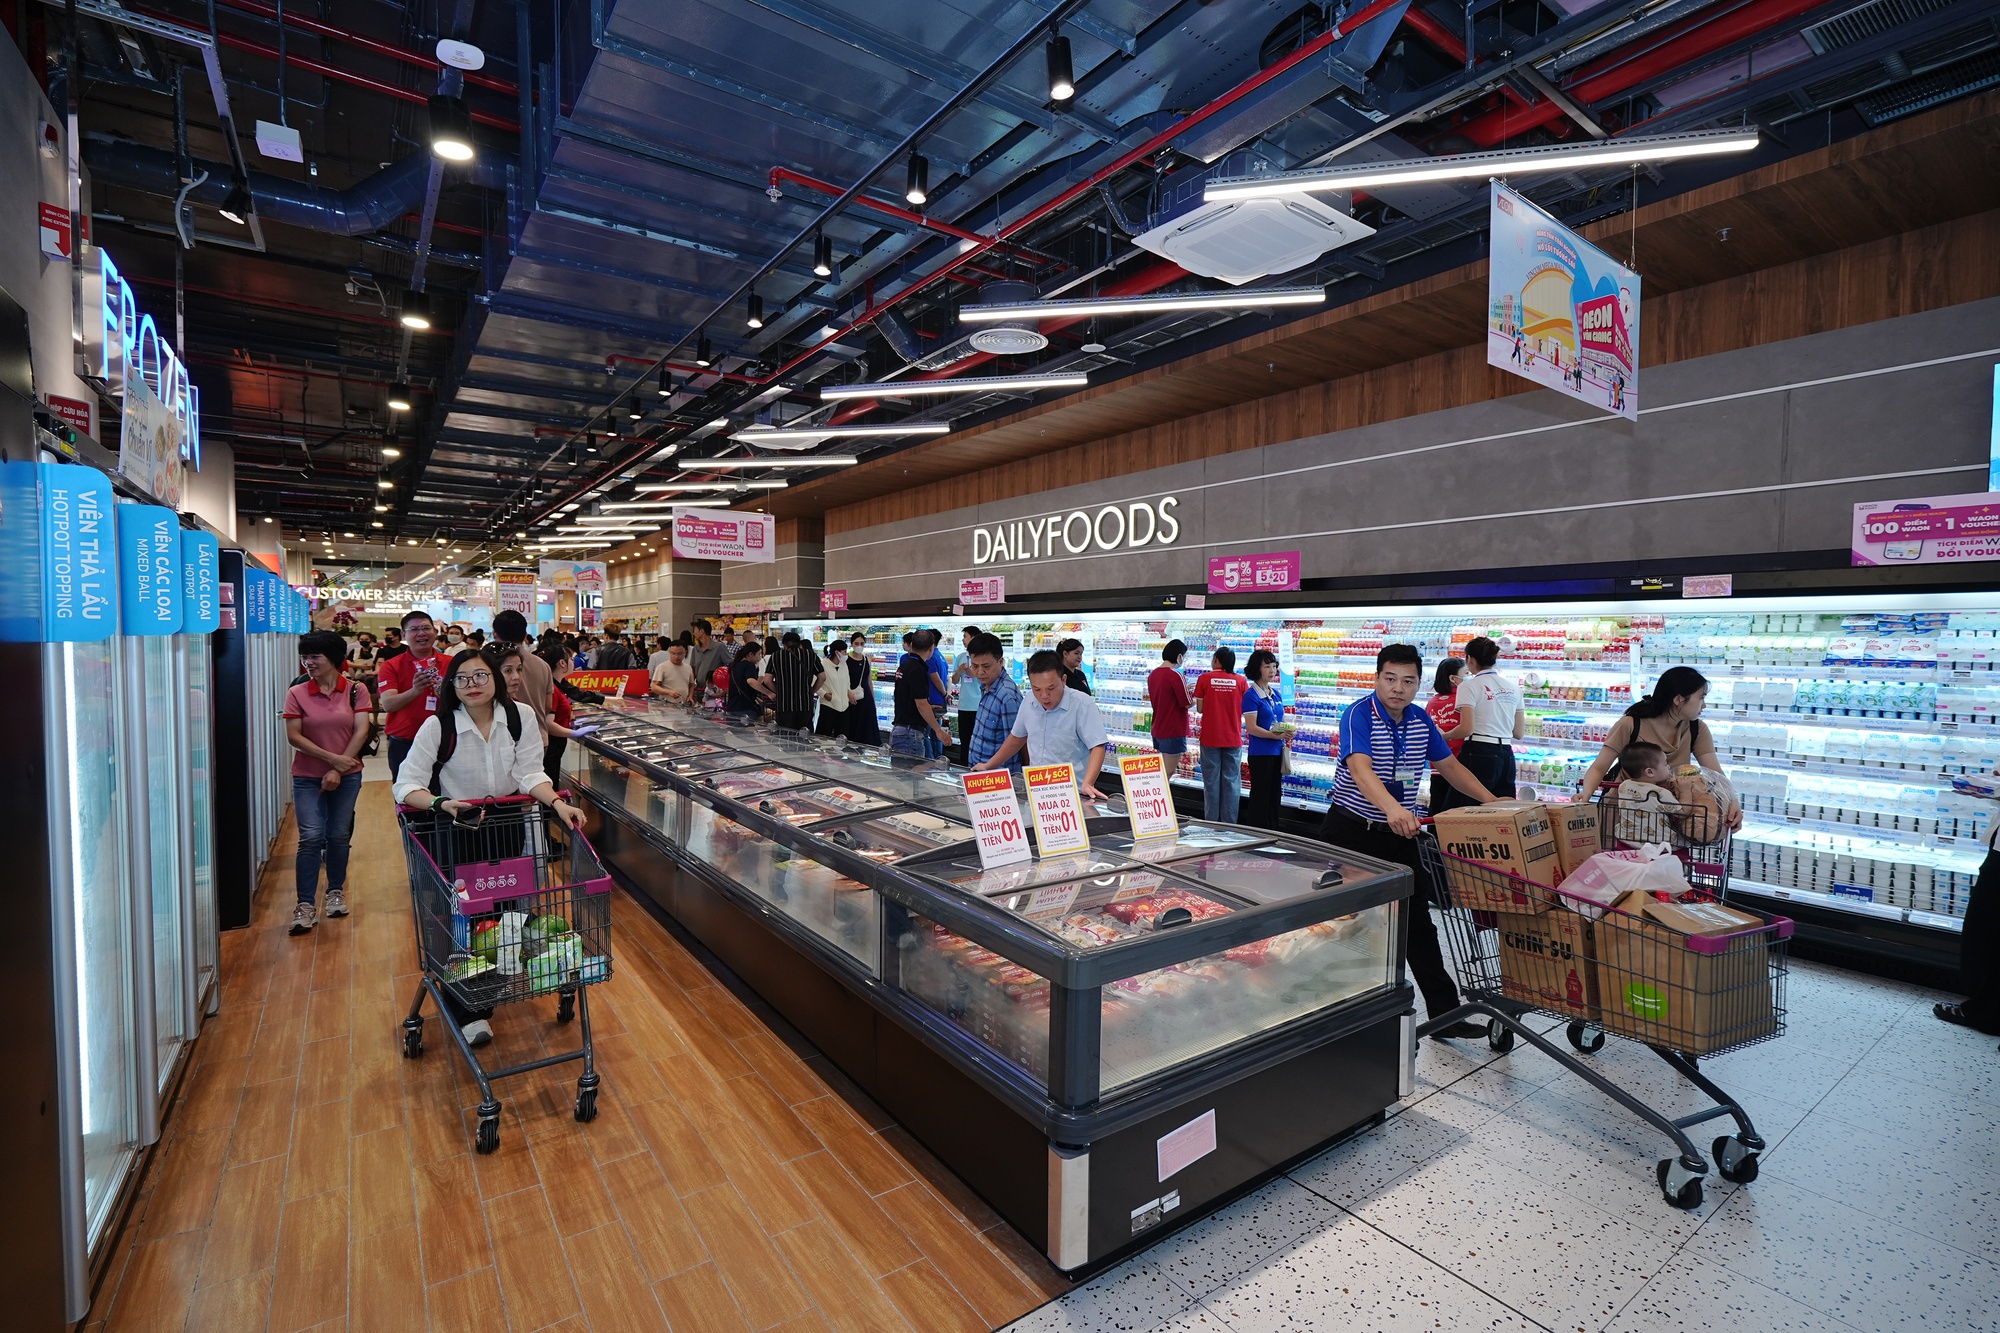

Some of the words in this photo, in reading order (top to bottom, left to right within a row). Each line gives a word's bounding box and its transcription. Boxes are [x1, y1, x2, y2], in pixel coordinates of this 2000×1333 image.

[1583, 303, 1613, 330] AEON
[1592, 331, 1613, 344] GIANG
[52, 489, 71, 551] HOTPOT
[78, 490, 103, 533] VIÊN
[676, 524, 693, 533] 100
[973, 496, 1180, 565] DAILYFOODS
[1862, 522, 1899, 535] 100
[1904, 518, 1928, 526] ĐIỂM
[1945, 518, 1955, 530] 1
[154, 520, 172, 553] VIÊN
[1960, 538, 1983, 546] ĐIỂM
[80, 538, 105, 578] THẢ
[136, 538, 150, 572] MIXED
[198, 543, 214, 566] LẨU
[1937, 546, 1961, 557] ĐỔI
[155, 556, 173, 585] CÁC
[1273, 572, 1286, 582] 20
[54, 556, 73, 619] TOPPING
[138, 576, 150, 602] BALL
[185, 563, 195, 600] HOTPOT
[198, 569, 211, 592] CÁC
[257, 580, 265, 604] THANH
[295, 587, 384, 600] CUSTOMER
[81, 583, 108, 620] LẨU
[153, 589, 171, 621] LOẠI
[197, 594, 211, 620] LOẠI
[269, 598, 277, 611] CÁC
[518, 600, 531, 613] 01
[257, 605, 266, 622] CUA
[1908, 735, 1941, 744] Vinamilk
[1125, 764, 1137, 772] GIÁ
[1144, 758, 1159, 768] SỐC
[967, 775, 994, 788] KHUYẾN
[994, 776, 1007, 786] MẠI
[1030, 771, 1044, 782] GIÁ
[1052, 767, 1068, 778] SỐC
[1132, 789, 1151, 798] MUA
[1152, 787, 1162, 796] 02
[1903, 787, 1937, 796] Vinamilk
[979, 807, 1000, 819] MUA
[1001, 805, 1012, 815] 02
[1038, 800, 1059, 810] MUA
[1060, 799, 1070, 808] 02
[1135, 799, 1153, 809] TÍNH
[1153, 798, 1168, 818] 01
[1040, 811, 1061, 823] TÍNH
[1061, 810, 1077, 832] 01
[1137, 810, 1154, 820] TIỀN
[978, 821, 1001, 833] TÍNH
[1001, 818, 1022, 842] 01
[1043, 823, 1062, 835] TIỀN
[1521, 819, 1549, 837] CHIN-SU
[1567, 817, 1595, 831] CHIN-SU
[982, 833, 1002, 847] TIỀN
[1447, 842, 1511, 860] CHIN-SU
[1505, 931, 1572, 960] CHIN-SU
